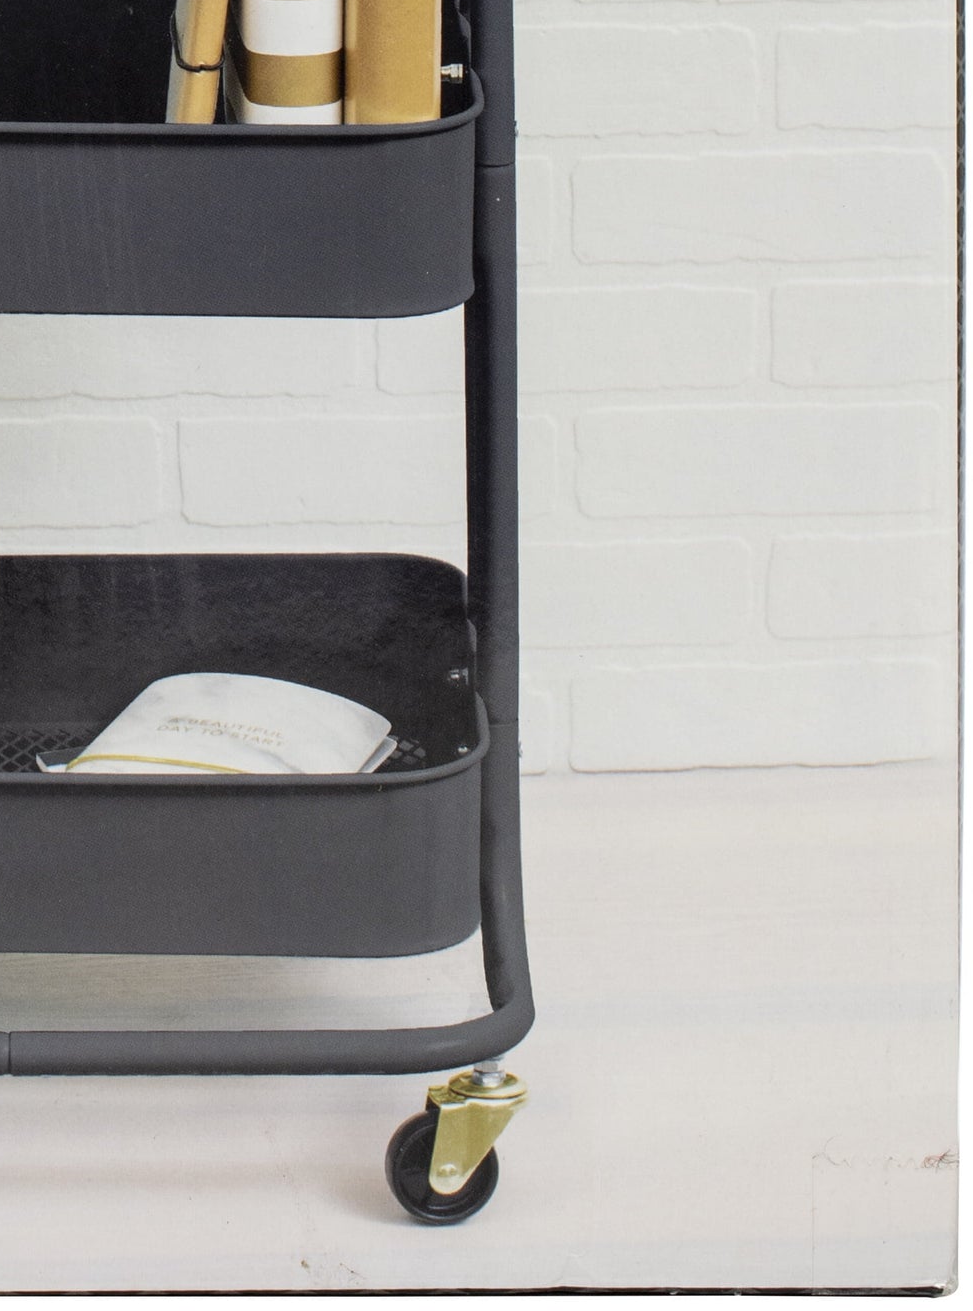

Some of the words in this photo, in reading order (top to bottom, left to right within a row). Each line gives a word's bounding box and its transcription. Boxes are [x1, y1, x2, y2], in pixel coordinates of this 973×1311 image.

[187, 718, 284, 738] BEAUTIFUL
[201, 728, 224, 737] TO
[230, 731, 284, 747] START
